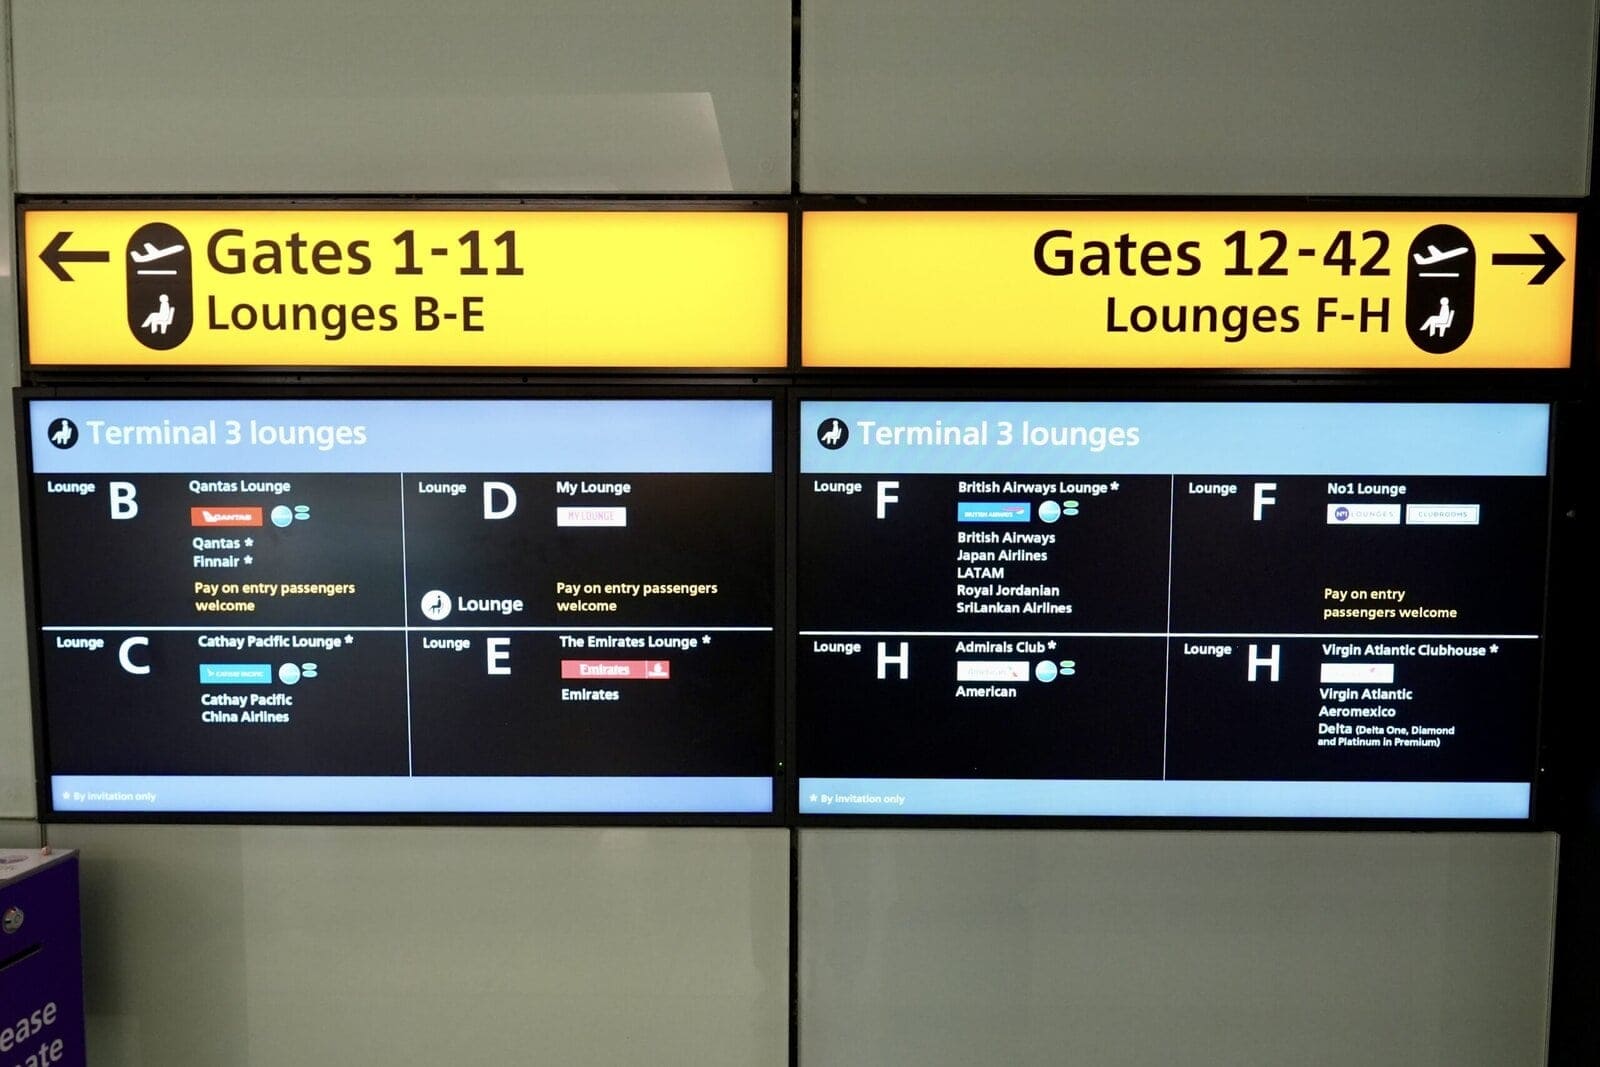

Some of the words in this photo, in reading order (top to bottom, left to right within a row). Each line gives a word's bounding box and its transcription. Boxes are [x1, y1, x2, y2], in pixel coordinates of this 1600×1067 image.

[208, 229, 371, 274] Gates
[394, 230, 523, 275] 1-11
[1034, 230, 1201, 276] Gates
[1224, 230, 1390, 276] 12-42
[209, 296, 397, 340] Lounges
[415, 297, 483, 331] B-E
[1107, 297, 1299, 342] Lounges
[1317, 298, 1389, 332] F-H
[87, 420, 215, 444] Terminal
[226, 421, 240, 444] 3
[251, 420, 366, 450] lounges
[858, 421, 987, 445] Terminal
[997, 422, 1012, 445] 3
[1023, 421, 1139, 452] lounges
[48, 481, 95, 495] Lounge
[189, 480, 238, 494] Qantas
[240, 480, 291, 495] Lounge
[419, 481, 466, 496] Lounge
[557, 481, 578, 496] My
[581, 481, 631, 495] Lounge
[814, 481, 862, 494] Lounge
[959, 481, 1000, 493] British
[1003, 481, 1056, 495] Airways
[1060, 482, 1108, 496] Lounge
[1189, 482, 1237, 496] Lounge
[1328, 483, 1354, 494] No1
[1358, 483, 1406, 497] Lounge
[110, 482, 138, 519] B
[483, 482, 517, 519] D
[877, 481, 899, 519] F
[1253, 483, 1277, 520] F
[568, 511, 580, 521] MY
[581, 511, 615, 521] LOUNGE
[1351, 510, 1394, 518] LOUNGES
[192, 537, 241, 551] Qantas
[958, 531, 999, 543] British
[1002, 532, 1055, 546] Airways
[193, 555, 240, 567] Finnair
[957, 550, 995, 563] Japan
[998, 549, 1047, 561] Airlines
[958, 567, 1004, 578] LATAM
[195, 582, 219, 596] Pay
[222, 584, 239, 593] on
[242, 583, 278, 596] entry
[281, 584, 355, 596] passengers
[557, 582, 581, 596] Pay
[584, 585, 601, 593] on
[605, 583, 640, 596] entry
[644, 585, 717, 596] passengers
[957, 584, 993, 598] Royal
[996, 584, 1059, 596] Jordanian
[1325, 588, 1347, 602] Pay
[1351, 591, 1367, 599] on
[1371, 590, 1405, 602] entry
[195, 600, 255, 611] welcome
[458, 596, 523, 615] Lounge
[557, 600, 617, 611] welcome
[957, 602, 1020, 613] SriLankan
[1023, 602, 1072, 613] Airlines
[1324, 609, 1395, 620] passengers
[1399, 607, 1457, 617] welcome
[57, 637, 104, 650] Lounge
[198, 635, 245, 650] Cathay
[247, 635, 290, 647] Pacific
[292, 635, 342, 650] Lounge
[423, 637, 470, 651] Lounge
[559, 635, 584, 647] The
[588, 636, 645, 647] Emirates
[648, 636, 697, 650] Lounge
[814, 641, 861, 655] Lounge
[956, 641, 1013, 653] Admirals
[1016, 641, 1045, 653] Club
[119, 636, 150, 674] C
[487, 637, 511, 674] E
[1184, 643, 1232, 657] Lounge
[1322, 644, 1361, 658] Virgin
[1364, 644, 1415, 655] Atlantic
[1418, 644, 1486, 656] Clubhouse
[877, 642, 908, 679] H
[1248, 645, 1280, 681] H
[580, 664, 631, 675] Emirates
[562, 688, 619, 700] Emirates
[956, 686, 1016, 697] American
[1320, 688, 1358, 702] Virgin
[1361, 688, 1412, 700] Atlantic
[201, 693, 248, 708] Cathay
[250, 693, 293, 706] Pacific
[202, 711, 238, 722] China
[241, 710, 289, 722] Airlines
[1319, 706, 1396, 717] Aeromexico
[1319, 723, 1352, 734] Delta
[1356, 725, 1384, 735] (Delta
[1386, 726, 1409, 735] One,
[1412, 726, 1455, 735] Diamond
[1318, 737, 1336, 745] and
[1338, 737, 1380, 746] Platinum
[1383, 737, 1392, 746] in
[1394, 737, 1440, 747] Premium)
[73, 792, 86, 803] By
[87, 791, 134, 801] invitation
[135, 792, 157, 803] only
[821, 794, 834, 805] By
[835, 793, 882, 803] invitation
[883, 794, 906, 806] only
